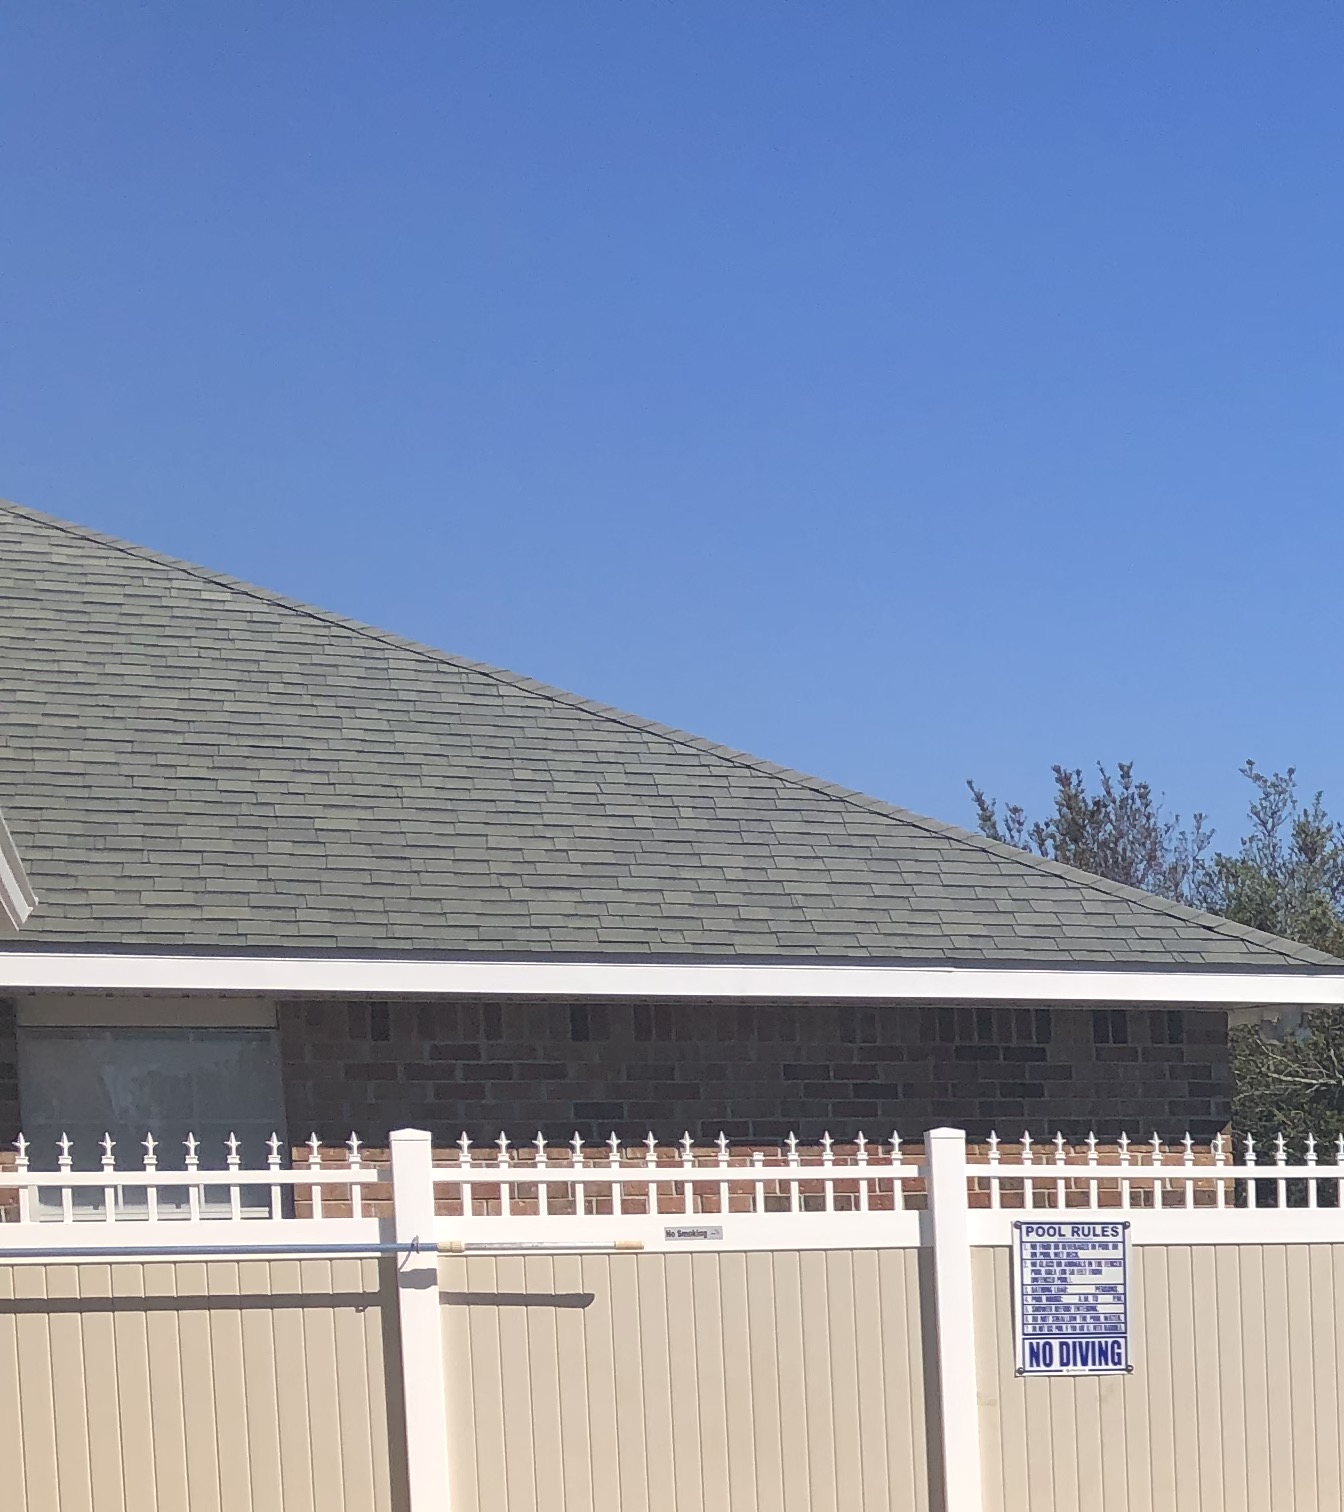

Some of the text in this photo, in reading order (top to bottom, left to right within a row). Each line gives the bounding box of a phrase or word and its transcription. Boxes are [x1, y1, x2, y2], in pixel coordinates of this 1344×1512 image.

[677, 1229, 707, 1238] Smoking
[1026, 1226, 1119, 1237] POOL RULES
[1029, 1340, 1122, 1367] NO DIVING
